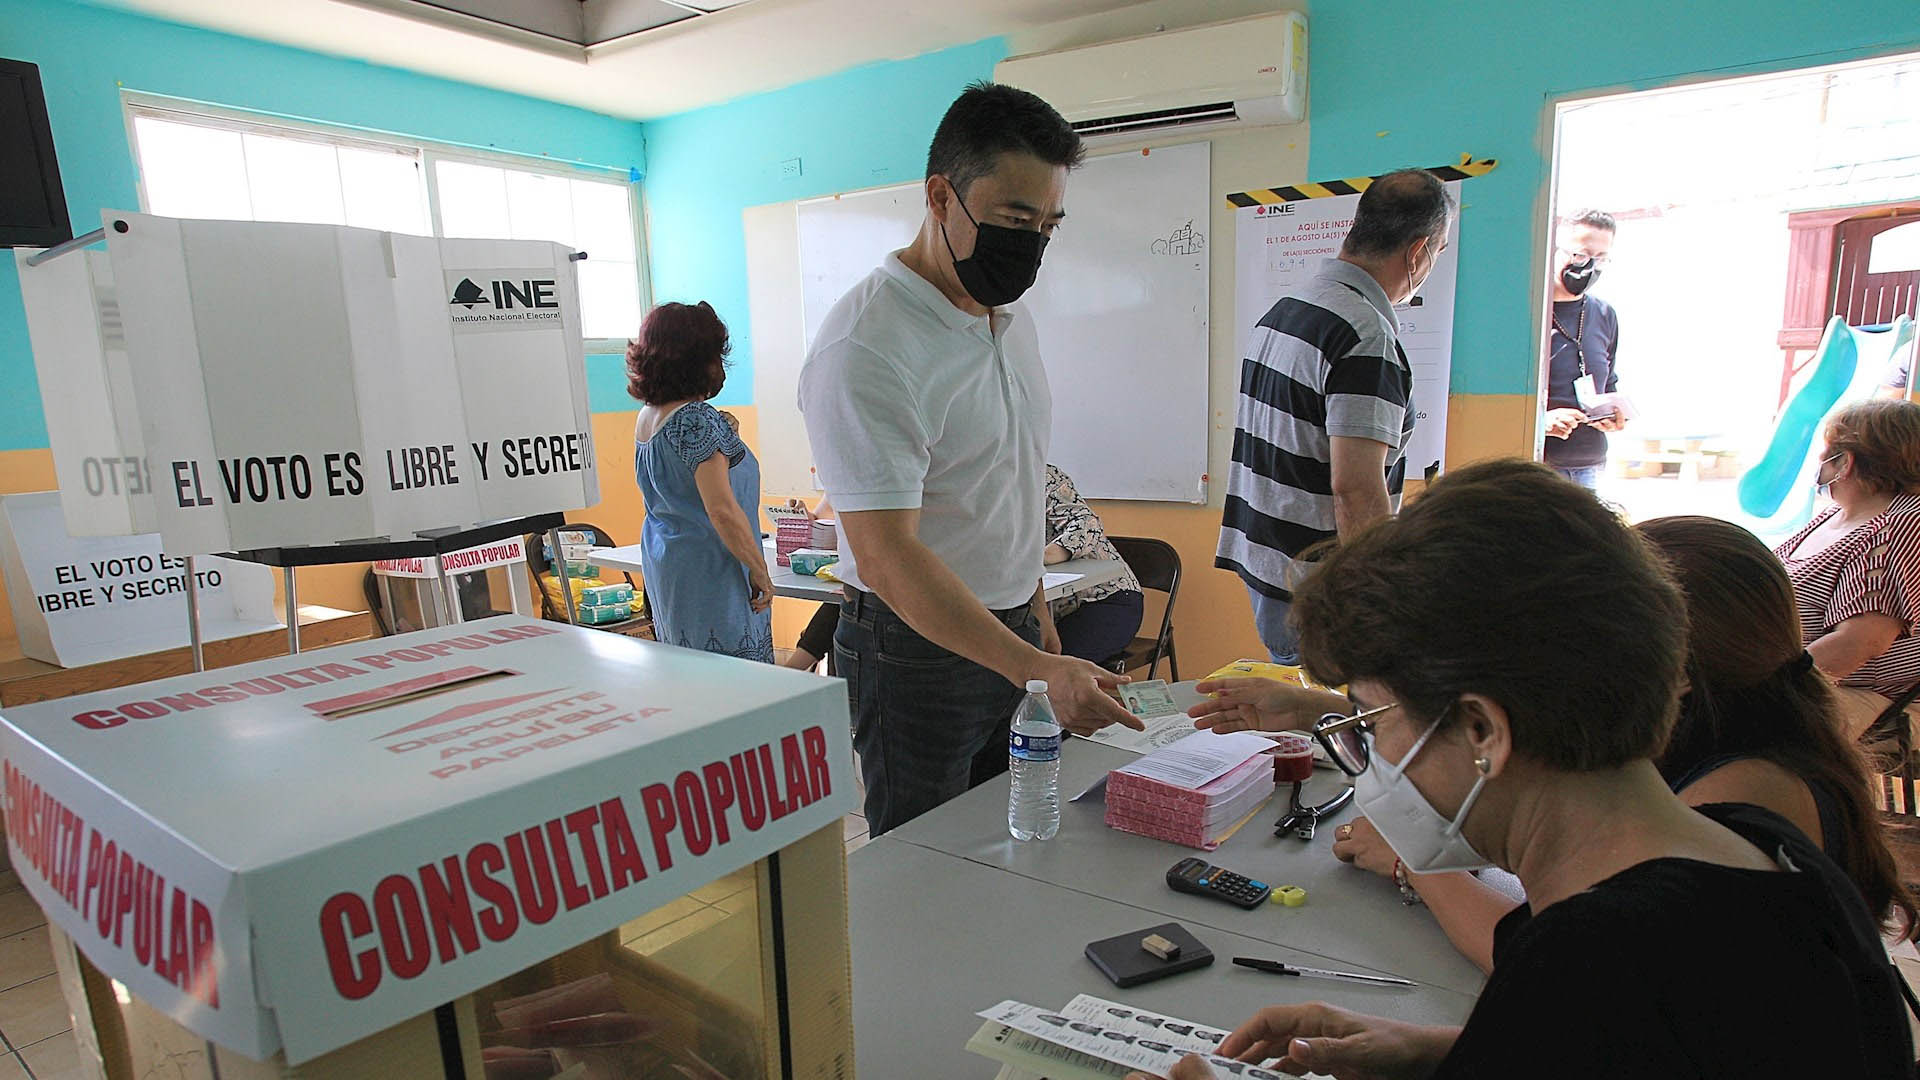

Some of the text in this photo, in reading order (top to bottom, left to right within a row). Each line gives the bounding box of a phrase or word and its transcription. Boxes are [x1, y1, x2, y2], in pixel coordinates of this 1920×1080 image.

[1268, 203, 1295, 214] INE
[1298, 219, 1356, 232] AQUÍ SE INSTA
[1280, 235, 1289, 243] DE
[1291, 233, 1320, 242] AGOSTO
[1322, 231, 1340, 240] LA(S)
[491, 280, 559, 310] INE
[452, 311, 561, 323] Instituto Nacional Electoral
[172, 432, 592, 508] EL VOTO ES LIBRE Y SECRETO
[55, 564, 87, 585] EL
[91, 555, 153, 579] VOTO
[442, 543, 521, 571] ONSULTA POPULAR
[37, 570, 222, 613] IBRE Y SECRTO
[71, 624, 563, 730] CONSULTA POPULAR
[385, 690, 608, 754] DEPOSITE
[429, 704, 673, 779] PAPELETA
[440, 703, 618, 760] AQUÍ SU
[4, 758, 220, 1011] CONSULTA POPULAR
[319, 725, 832, 1001] CONSULTA POPULAR
